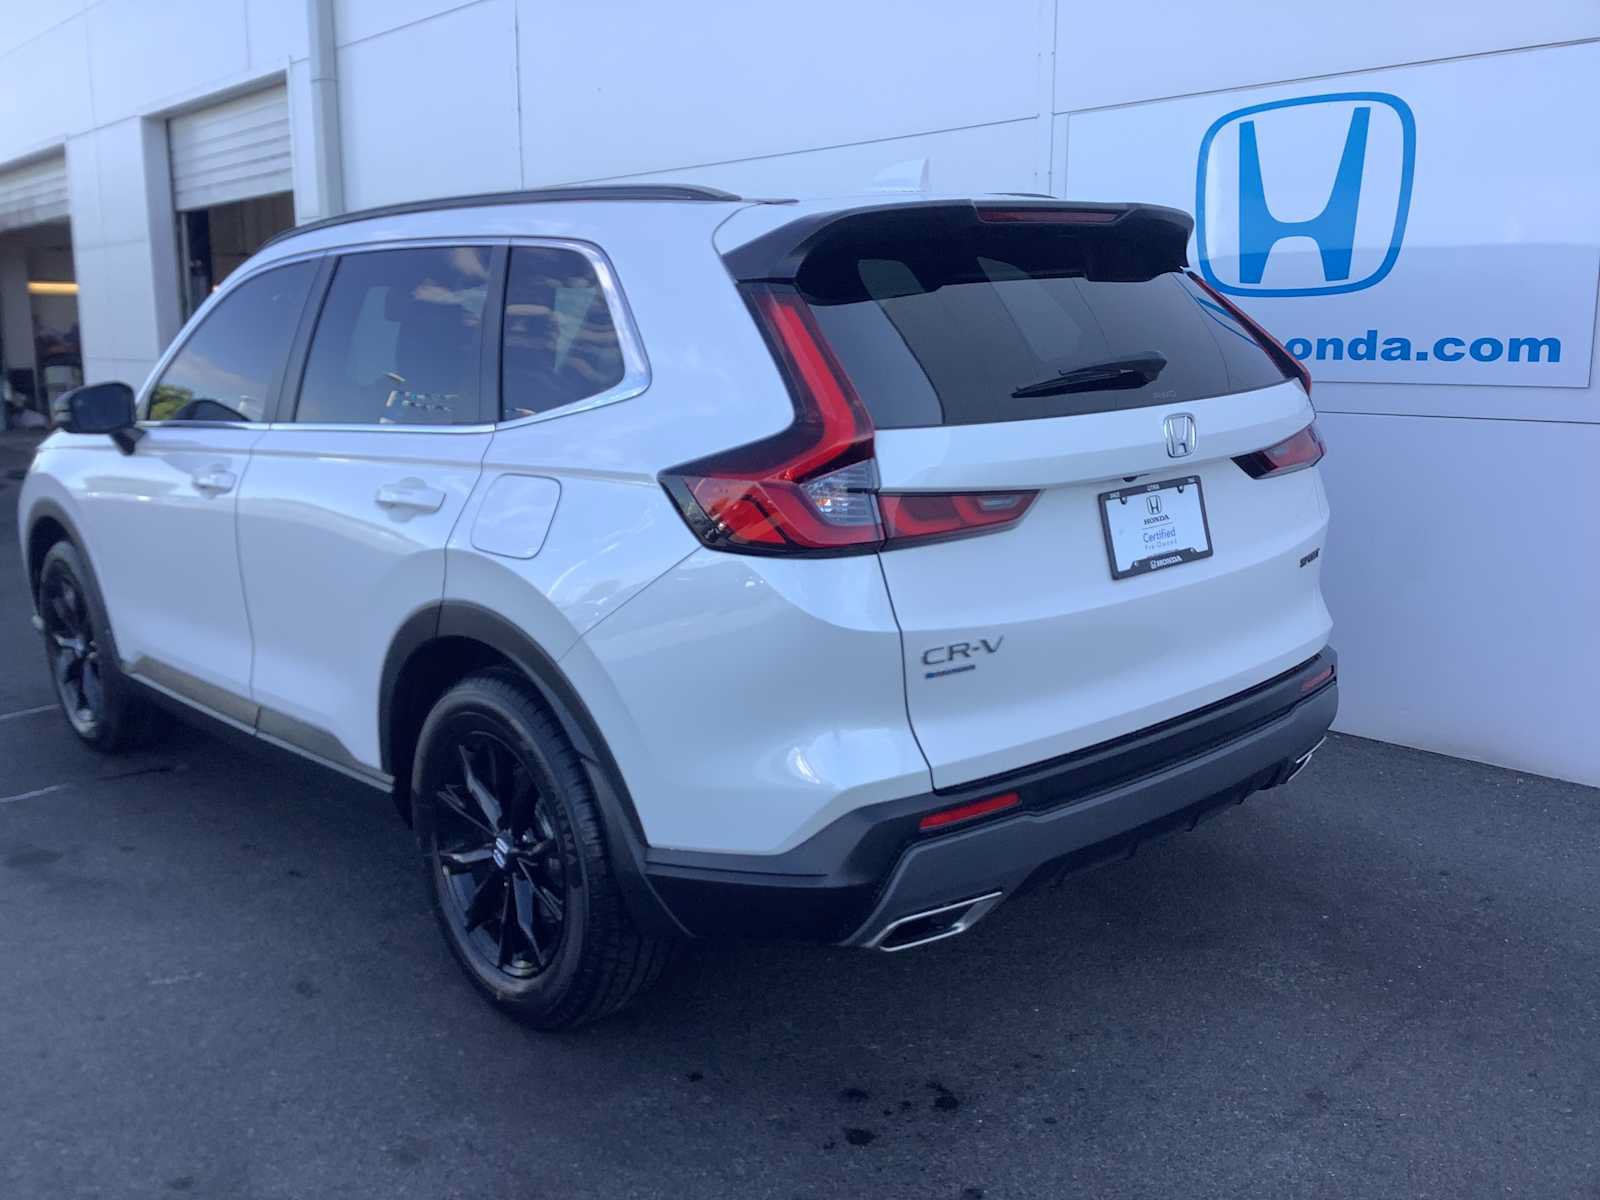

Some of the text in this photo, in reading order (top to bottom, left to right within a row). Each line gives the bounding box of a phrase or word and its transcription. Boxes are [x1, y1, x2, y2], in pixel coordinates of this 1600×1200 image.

[1284, 330, 1561, 363] onda.com
[1143, 514, 1170, 525] HONDA
[1143, 527, 1176, 543] Certified
[923, 635, 1004, 665] CR-V
